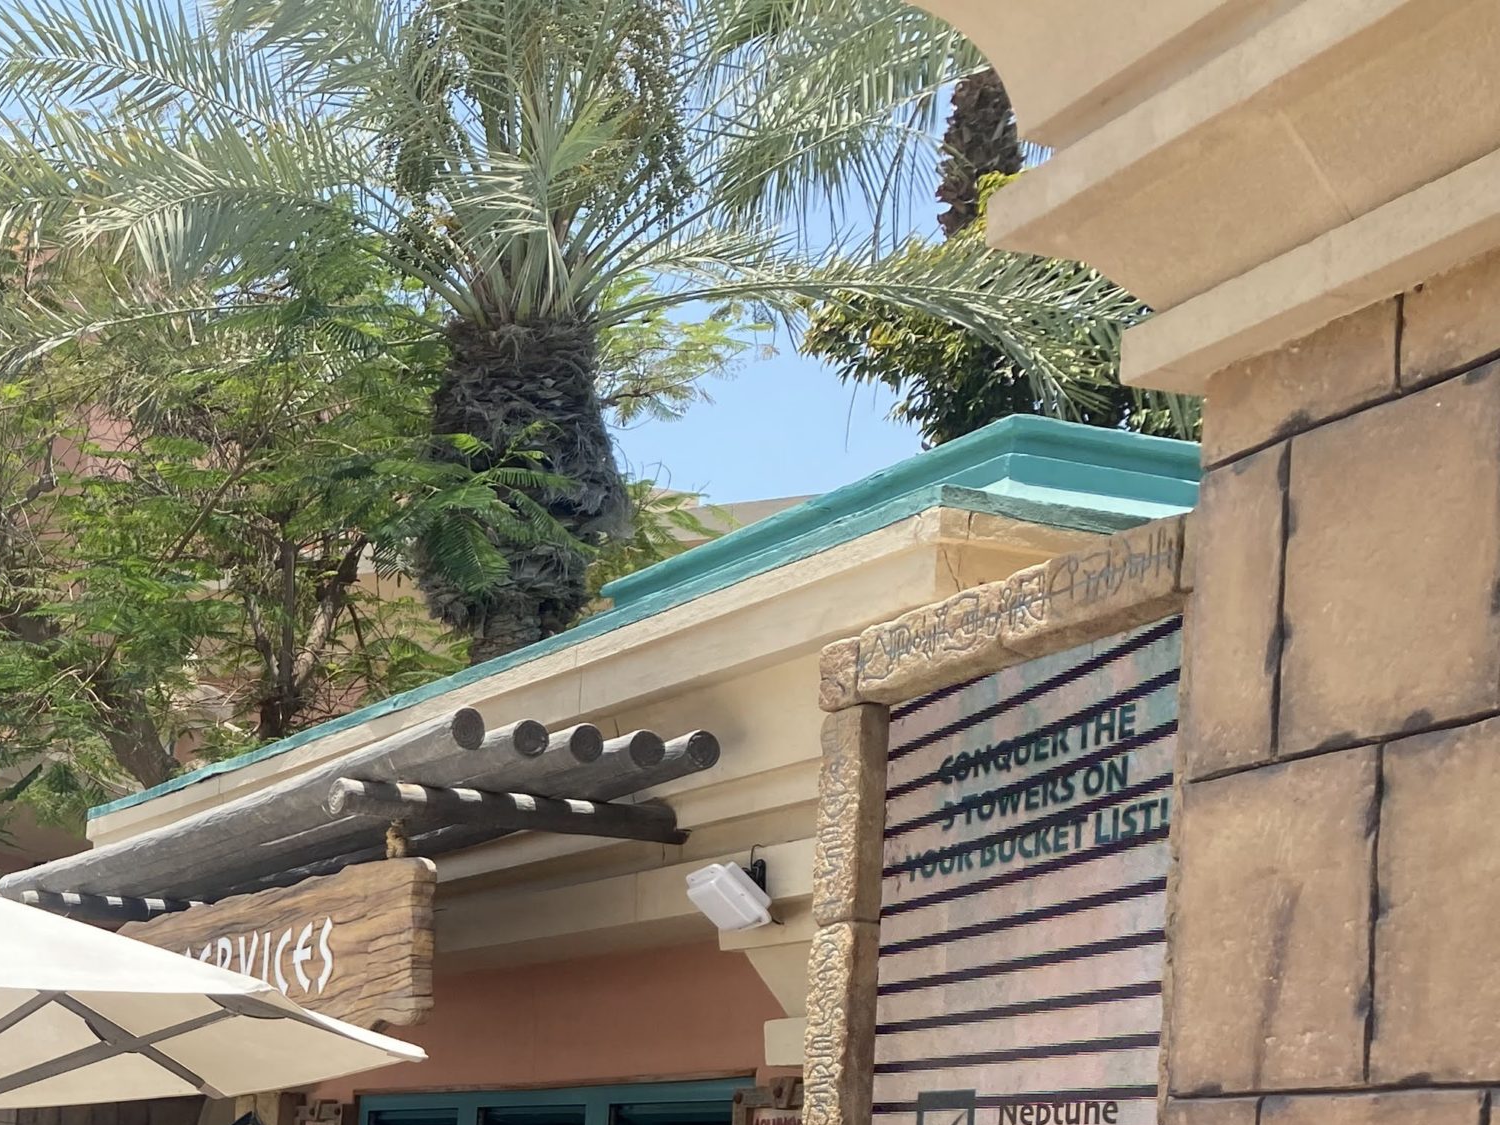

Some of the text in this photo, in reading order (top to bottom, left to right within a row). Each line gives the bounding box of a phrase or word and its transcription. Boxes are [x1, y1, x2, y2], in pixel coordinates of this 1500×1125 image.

[939, 703, 1137, 785] CONQUER THE
[963, 771, 1077, 826] TOWERS
[1083, 755, 1129, 797] ON
[906, 797, 1169, 882] YOUR BUCKET LIST!
[185, 916, 333, 995] RVICES
